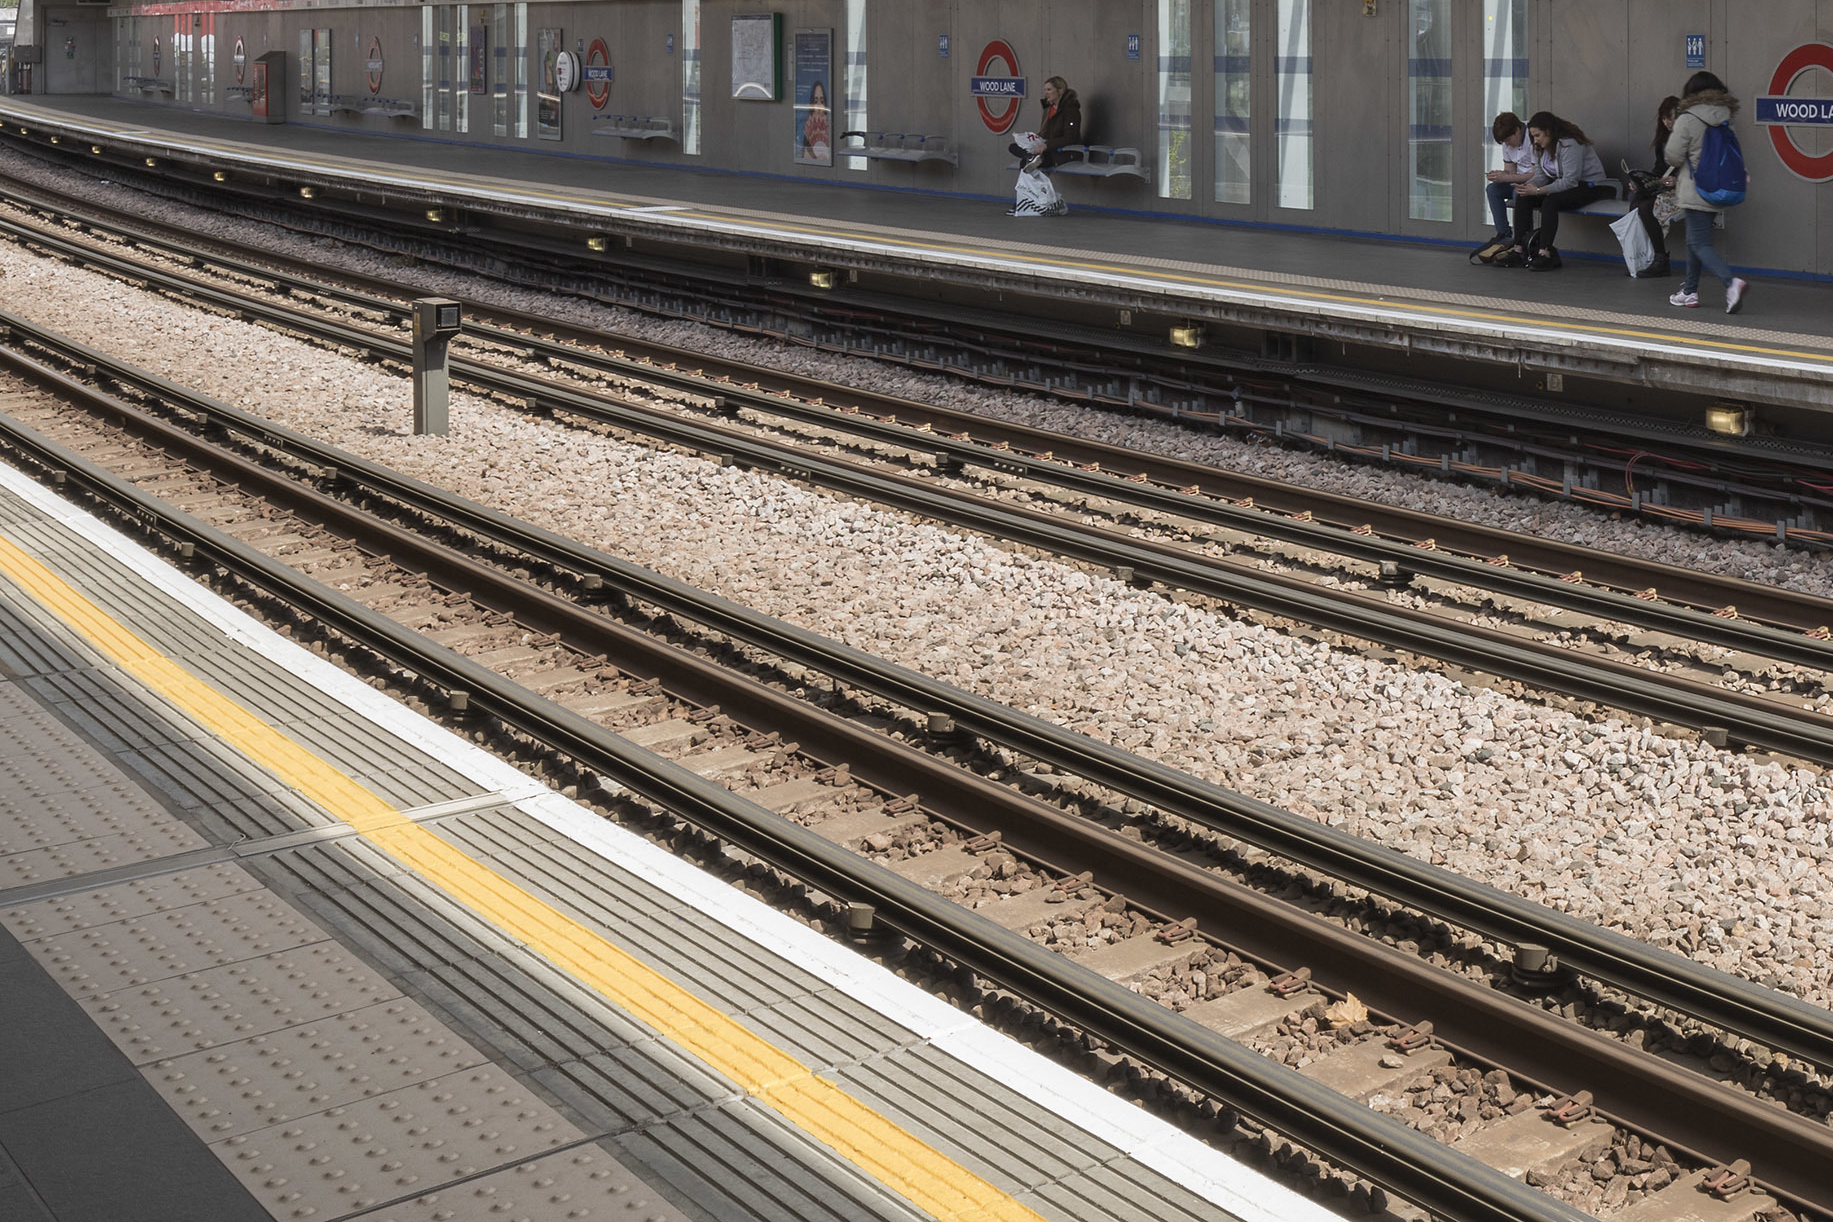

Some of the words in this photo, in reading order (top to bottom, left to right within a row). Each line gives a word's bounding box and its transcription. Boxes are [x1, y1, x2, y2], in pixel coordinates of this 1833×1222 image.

[980, 81, 999, 92] WOOD
[1000, 81, 1015, 92] LANE
[1776, 103, 1817, 119] WOOD
